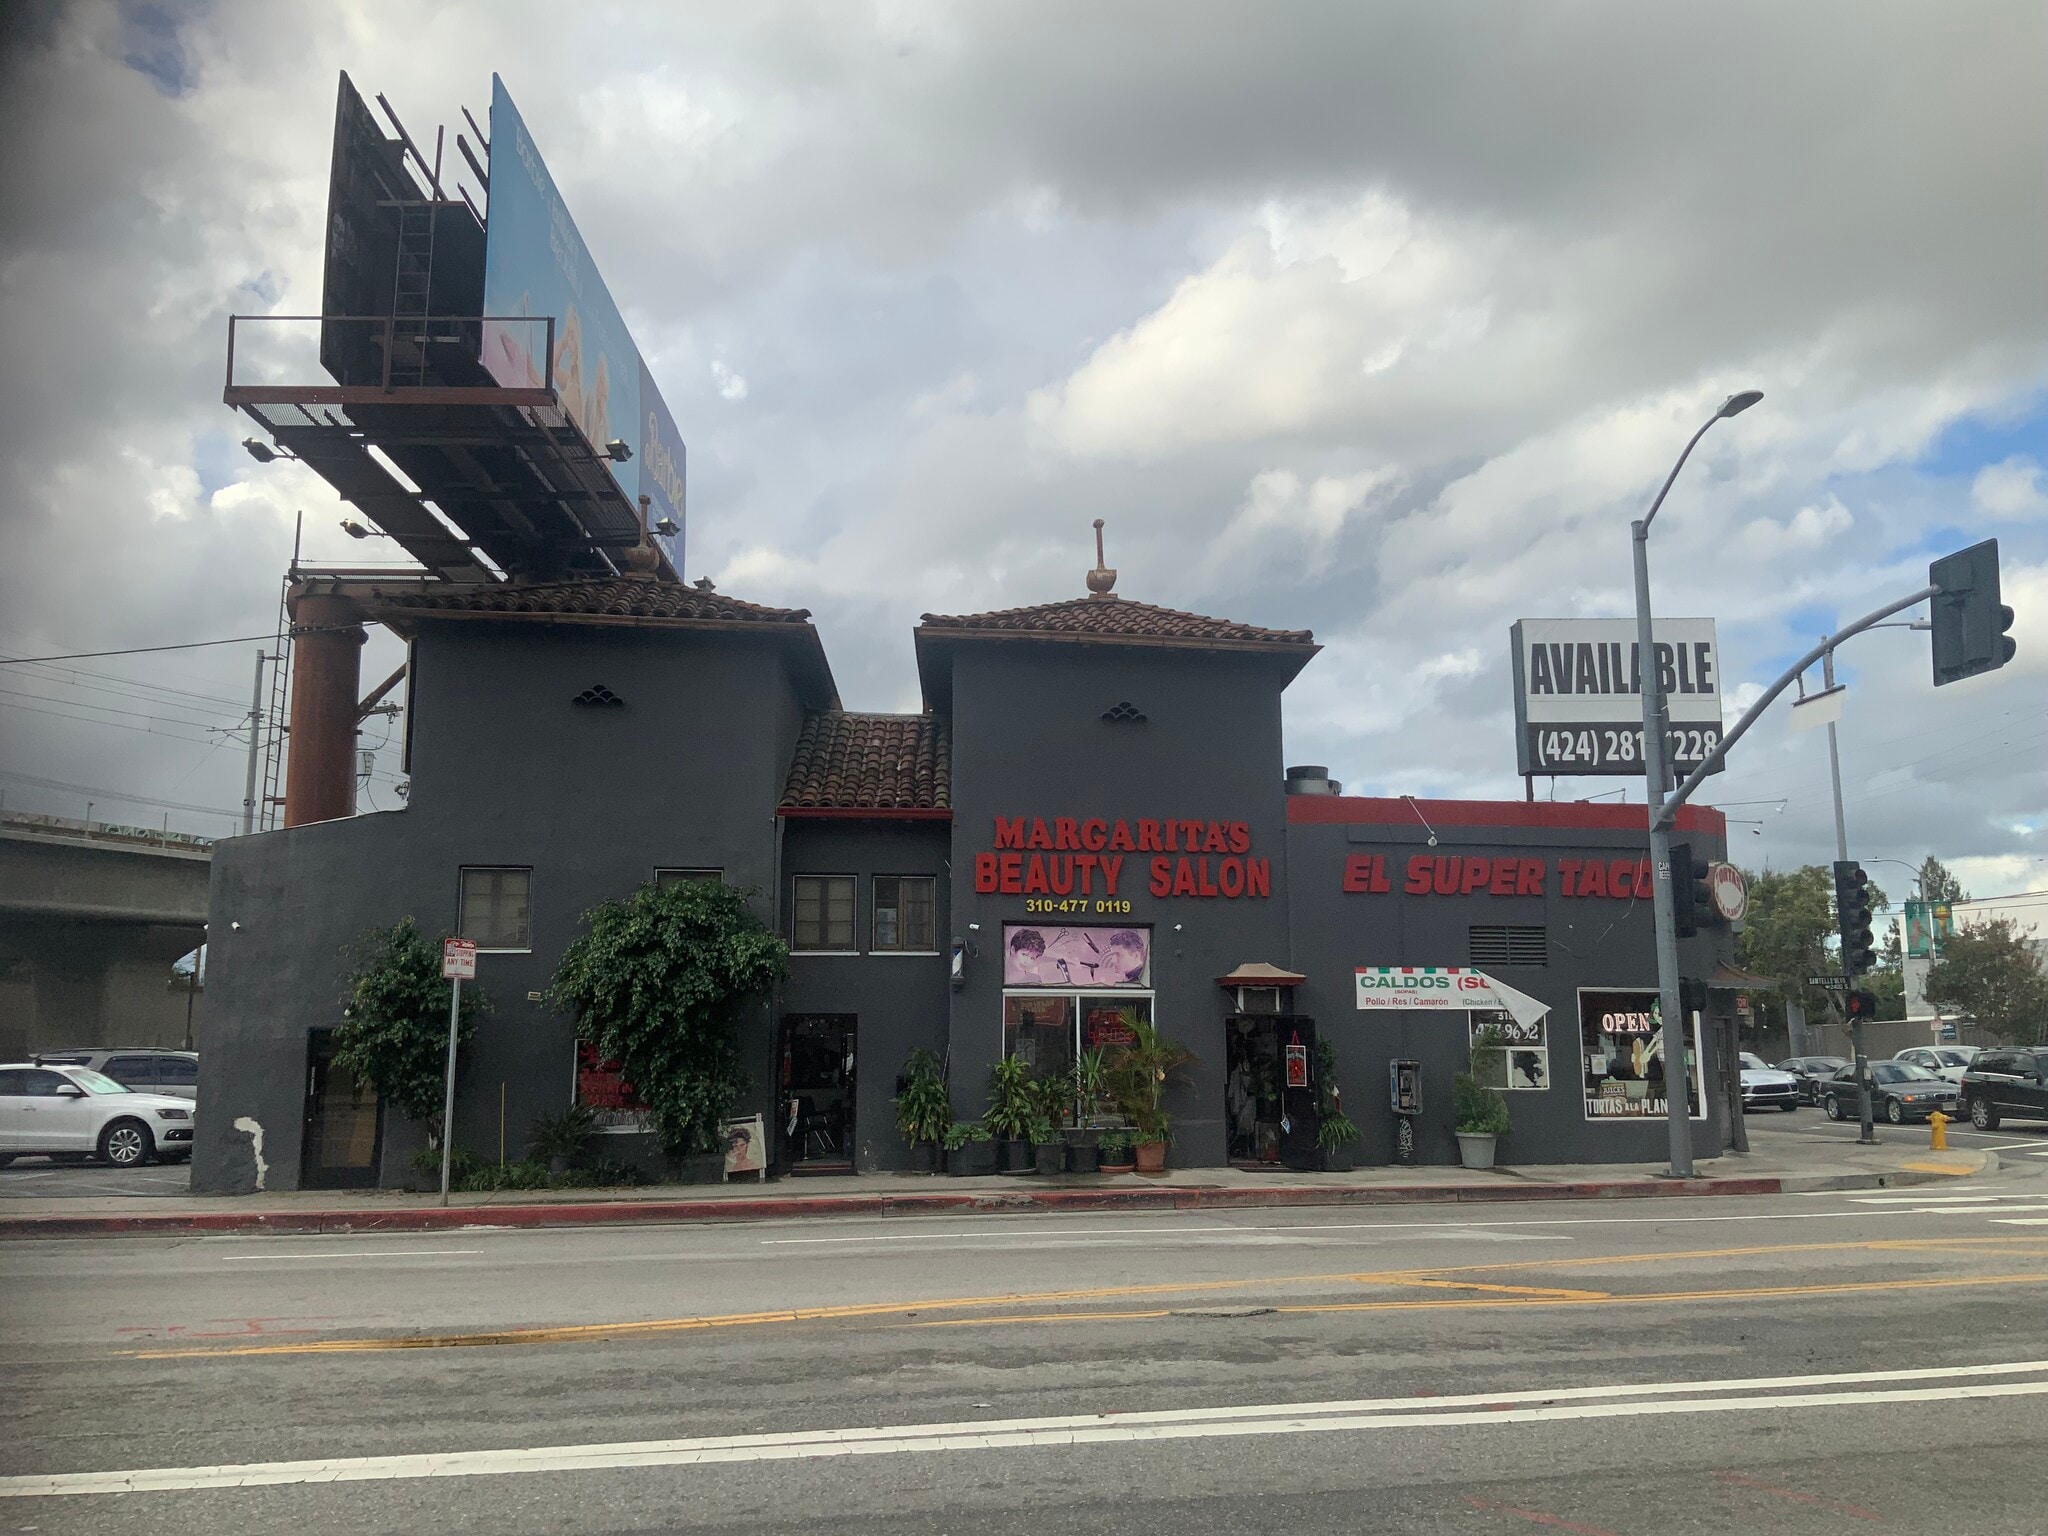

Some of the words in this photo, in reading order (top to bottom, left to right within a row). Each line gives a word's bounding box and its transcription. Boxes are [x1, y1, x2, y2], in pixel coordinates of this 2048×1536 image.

[1530, 642, 1714, 694] AVAILABLE
[1537, 730, 1599, 766] (424)
[994, 816, 1251, 854] MARGARITA'S
[975, 852, 1123, 896] BEAUTY
[1149, 855, 1271, 898] SALON
[1342, 853, 1392, 893] EL
[1404, 855, 1547, 897] SUPER
[1026, 899, 1088, 913] 310-477
[1096, 900, 1131, 914] 0119
[447, 958, 459, 966] ANY
[460, 959, 474, 967] TIME
[1360, 976, 1450, 988] CALDOS
[1365, 997, 1386, 1005] Pollo
[1413, 997, 1449, 1006] Camarón
[1462, 998, 1493, 1007] (Chicken
[1602, 1012, 1650, 1032] OPEN
[1603, 1086, 1625, 1095] JUICES
[1587, 1099, 1623, 1114] TORTAS
